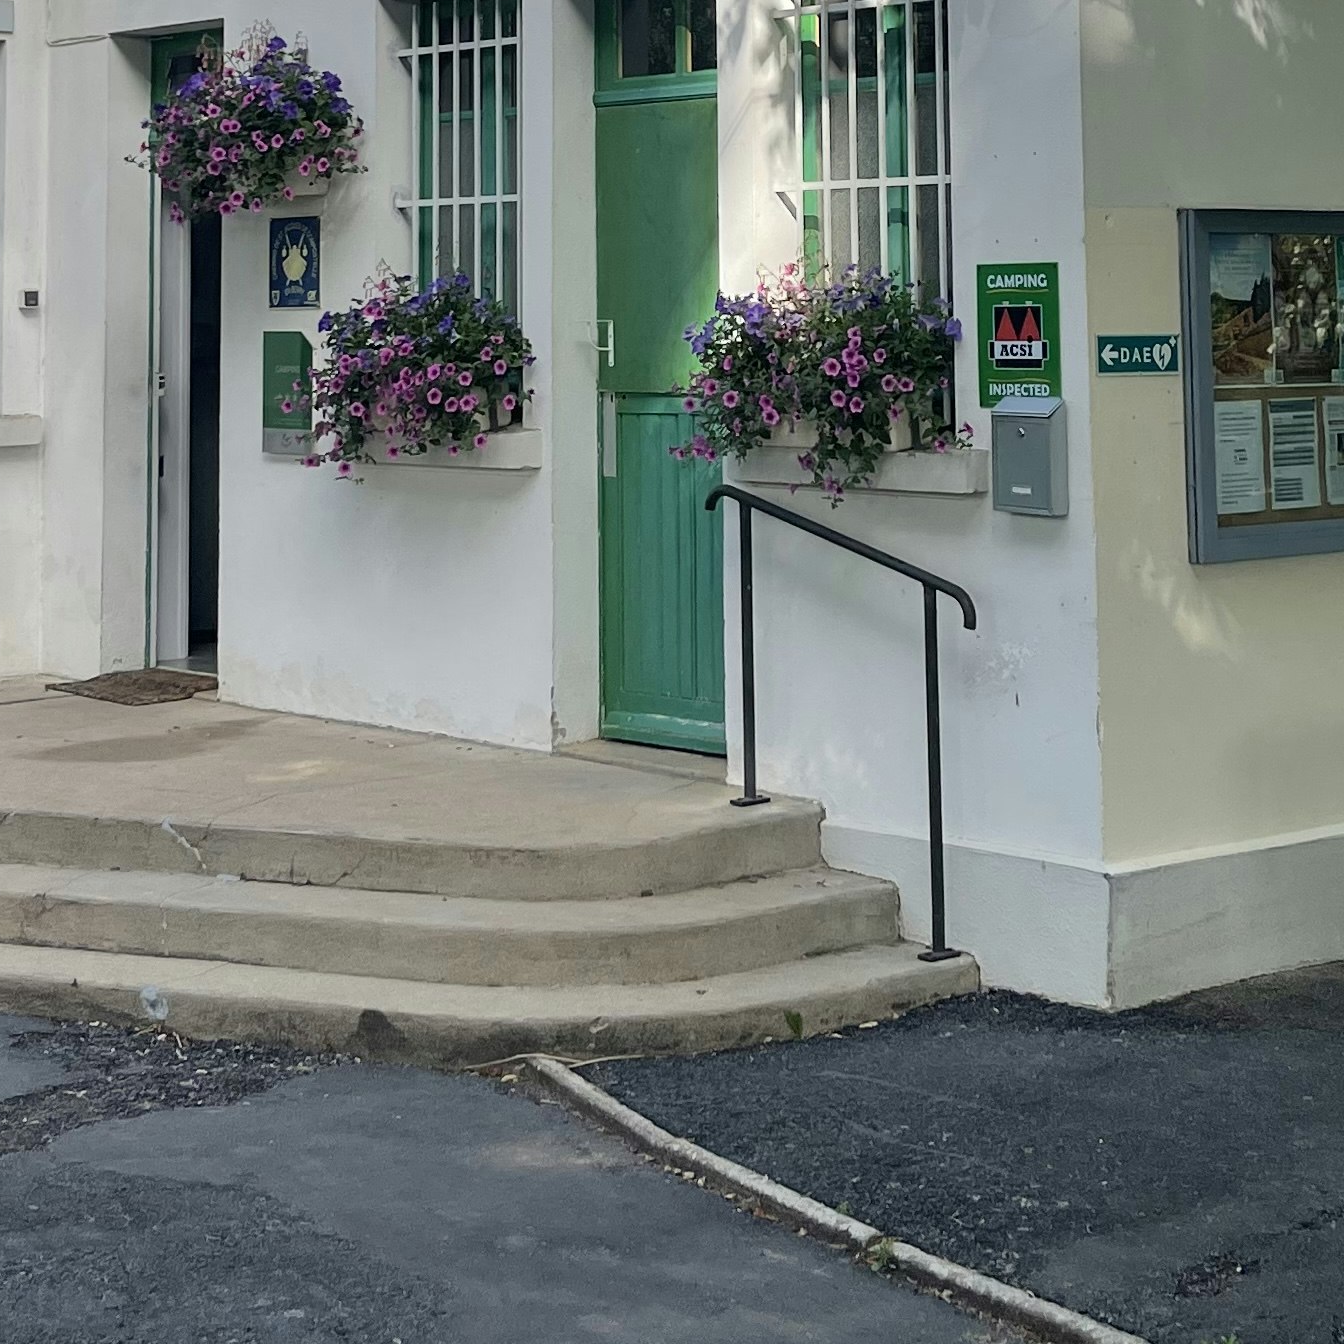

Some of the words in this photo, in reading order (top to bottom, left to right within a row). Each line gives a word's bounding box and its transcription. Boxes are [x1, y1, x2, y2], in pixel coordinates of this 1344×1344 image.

[986, 274, 1048, 288] CAMPING
[999, 340, 1033, 357] ACSI
[1120, 346, 1151, 363] DAE
[989, 384, 1050, 397] INSPECTED
